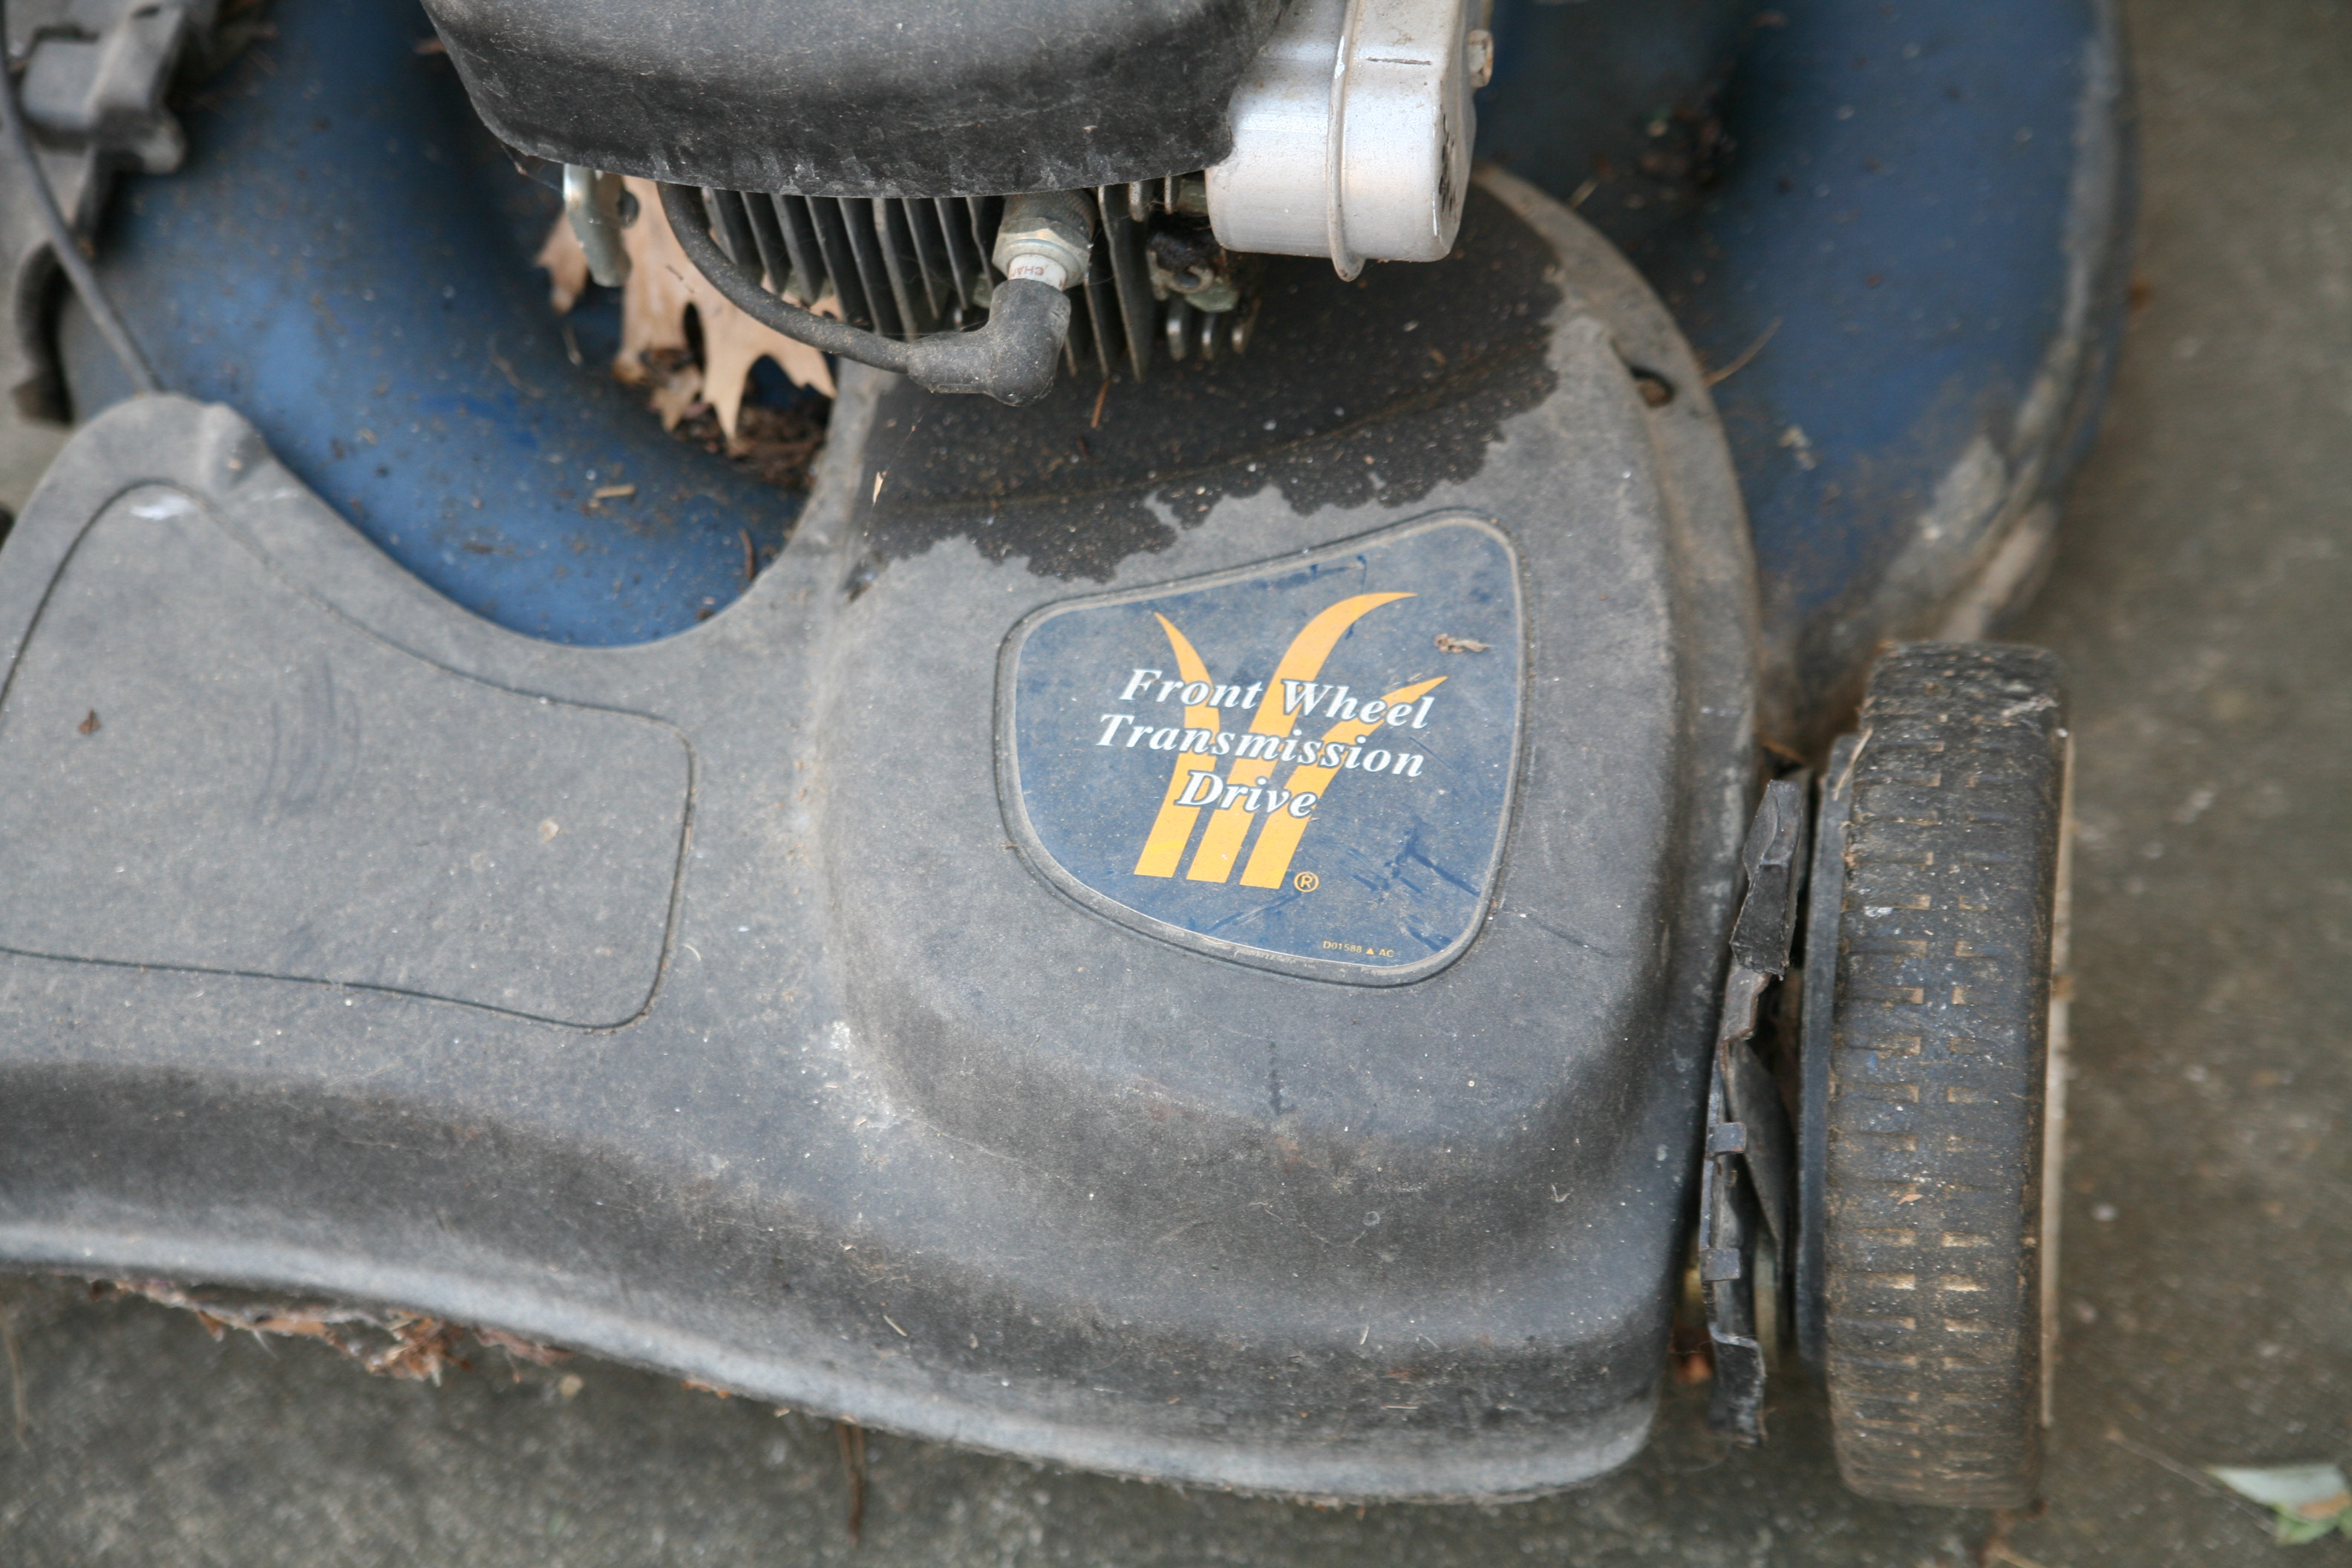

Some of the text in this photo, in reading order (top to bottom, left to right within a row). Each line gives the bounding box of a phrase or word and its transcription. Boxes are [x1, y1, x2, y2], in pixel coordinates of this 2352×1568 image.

[1119, 668, 1435, 730] Front Wheel
[1095, 713, 1424, 778] Transmission
[1175, 770, 1319, 818] Drive
[1322, 940, 1394, 958] D01588 AC
